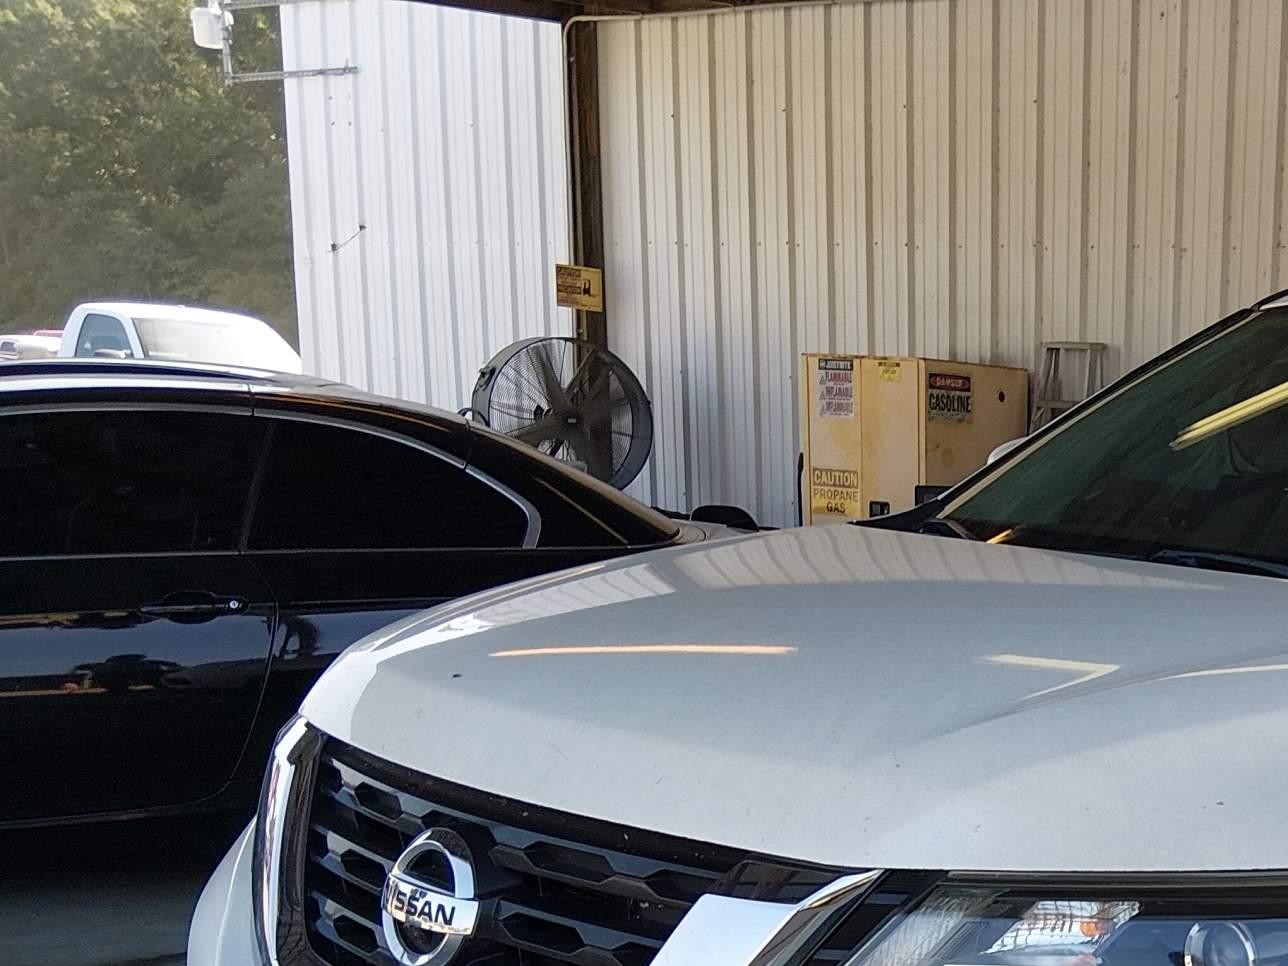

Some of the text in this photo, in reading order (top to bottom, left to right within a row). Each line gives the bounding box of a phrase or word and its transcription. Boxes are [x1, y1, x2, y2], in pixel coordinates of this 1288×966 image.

[929, 392, 972, 413] GASOLINE
[814, 470, 858, 487] CAUTION
[813, 487, 859, 502] PROPANE
[826, 501, 847, 514] GAS
